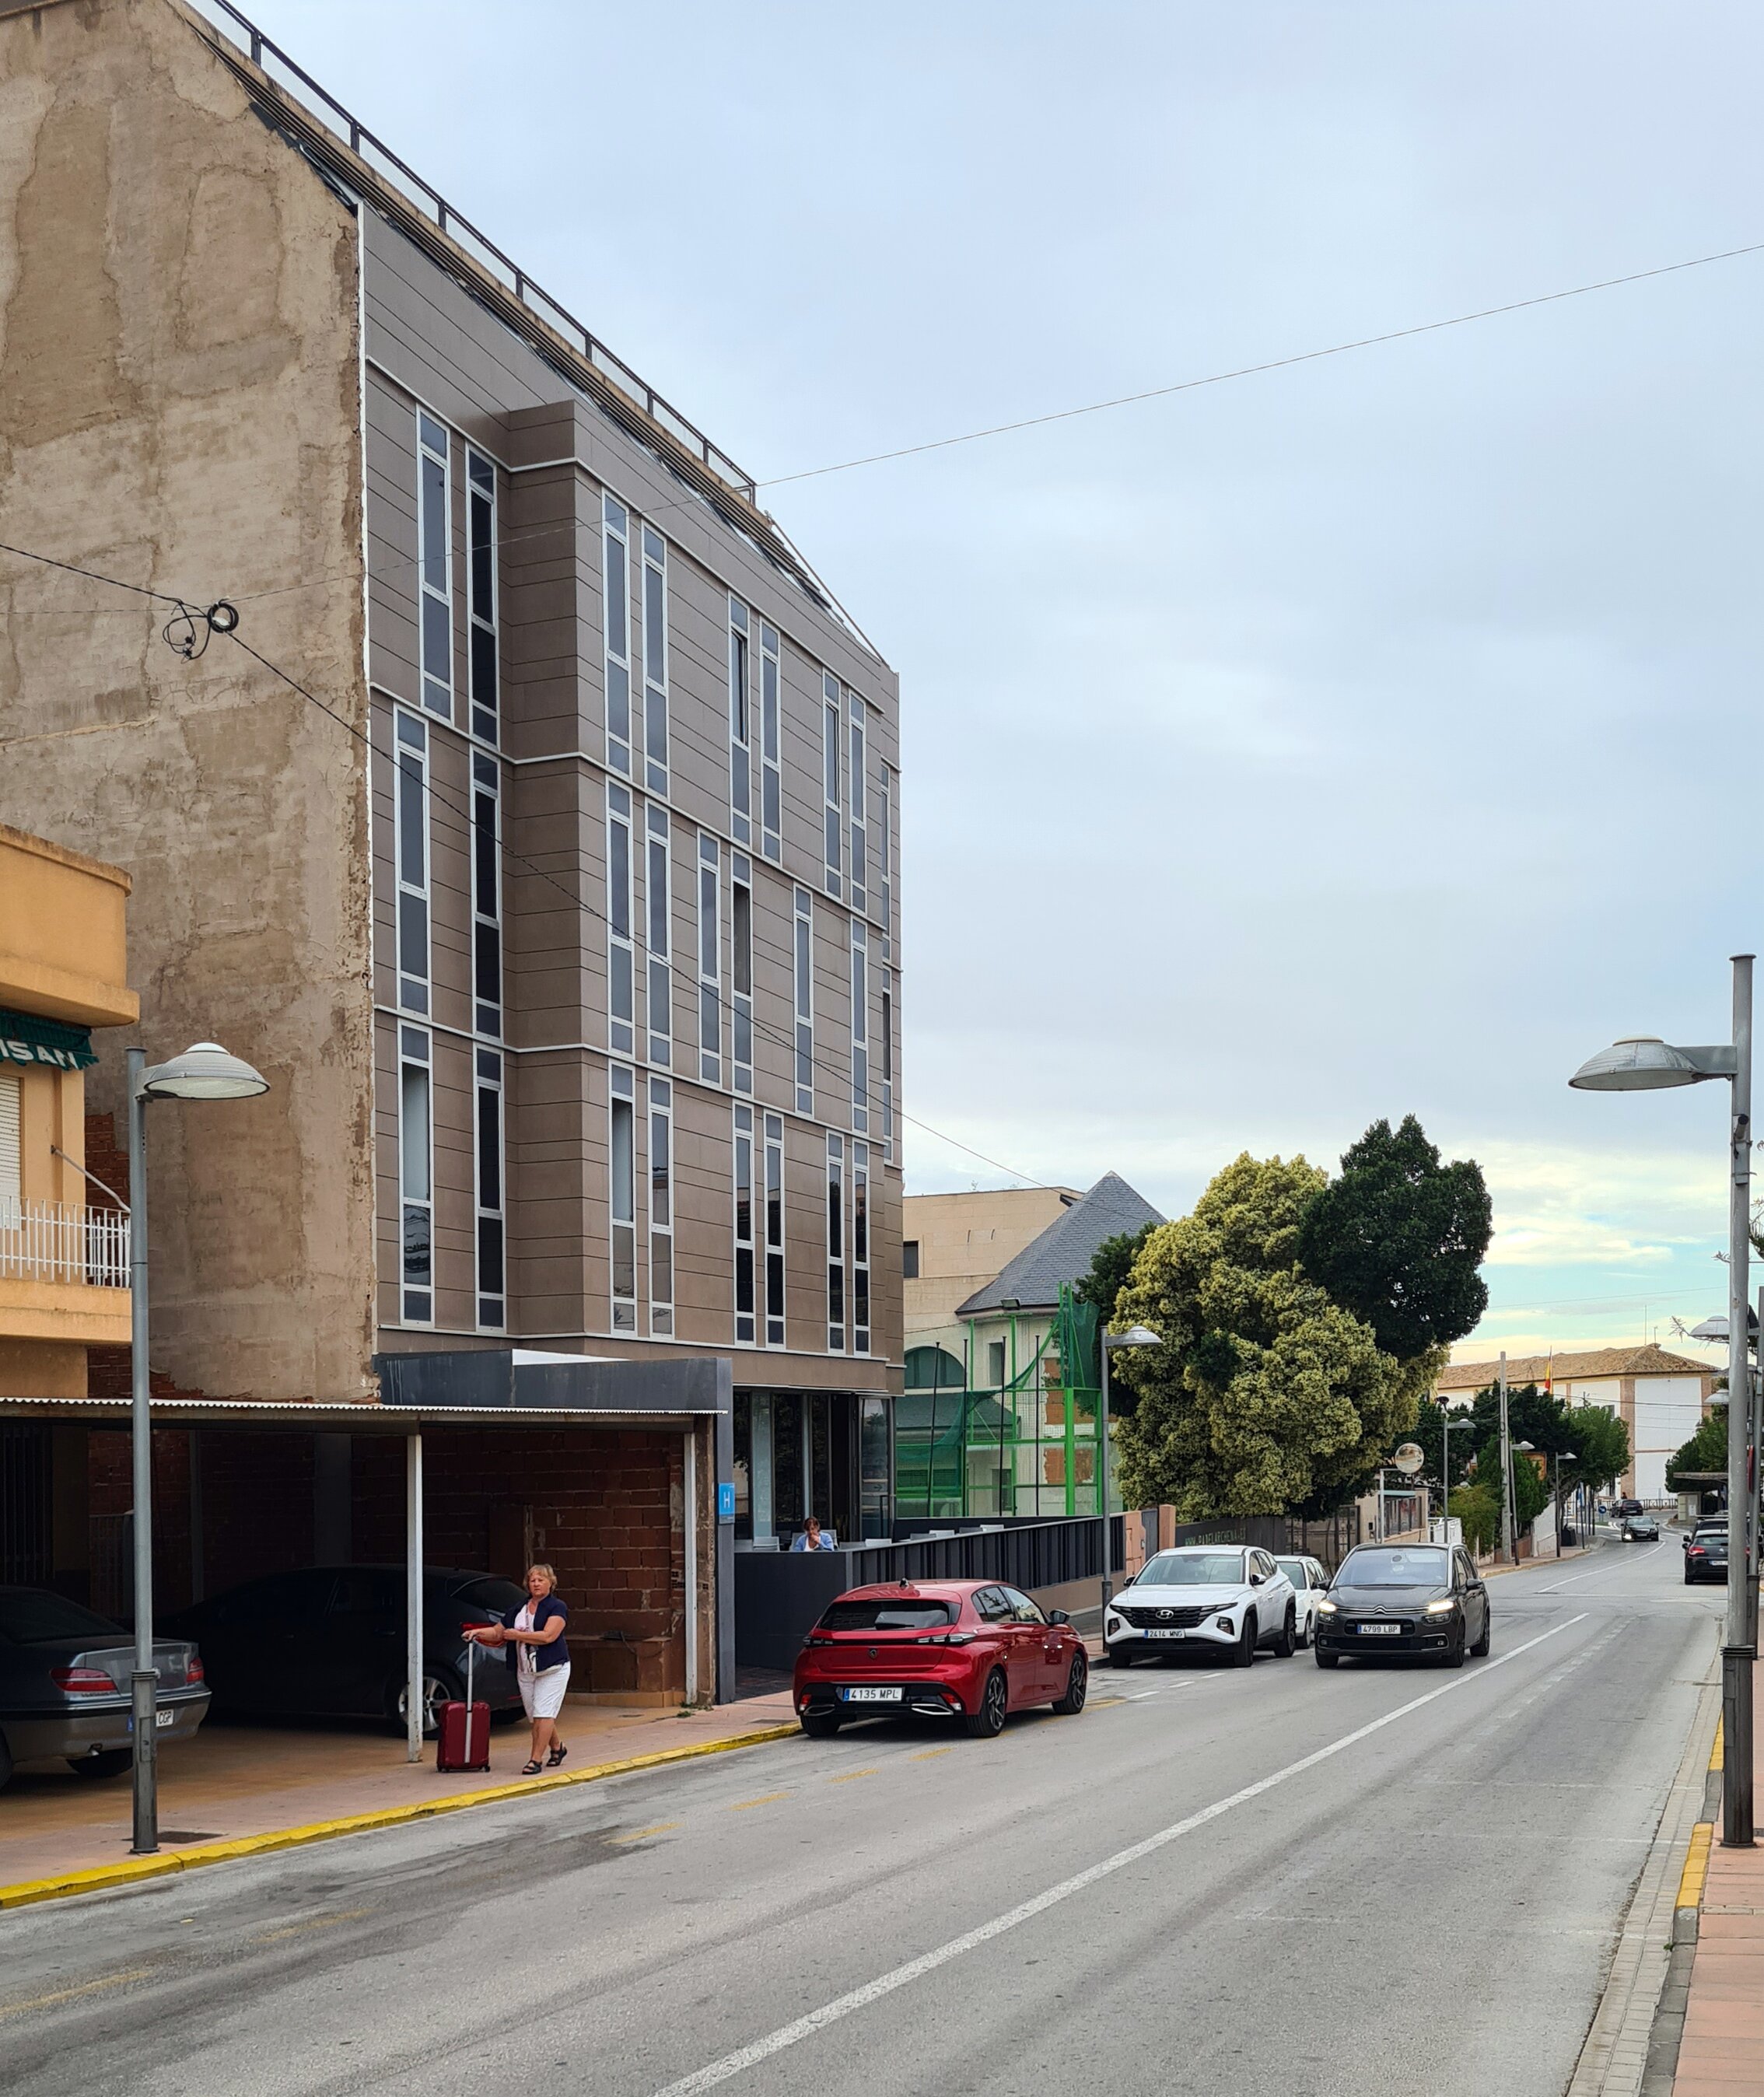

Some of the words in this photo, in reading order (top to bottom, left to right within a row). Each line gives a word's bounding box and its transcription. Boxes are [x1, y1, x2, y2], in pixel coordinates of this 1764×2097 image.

[723, 1491, 730, 1508] H
[851, 1689, 876, 1699] 4135
[879, 1689, 898, 1699] MPL
[158, 1710, 172, 1724] CGP
